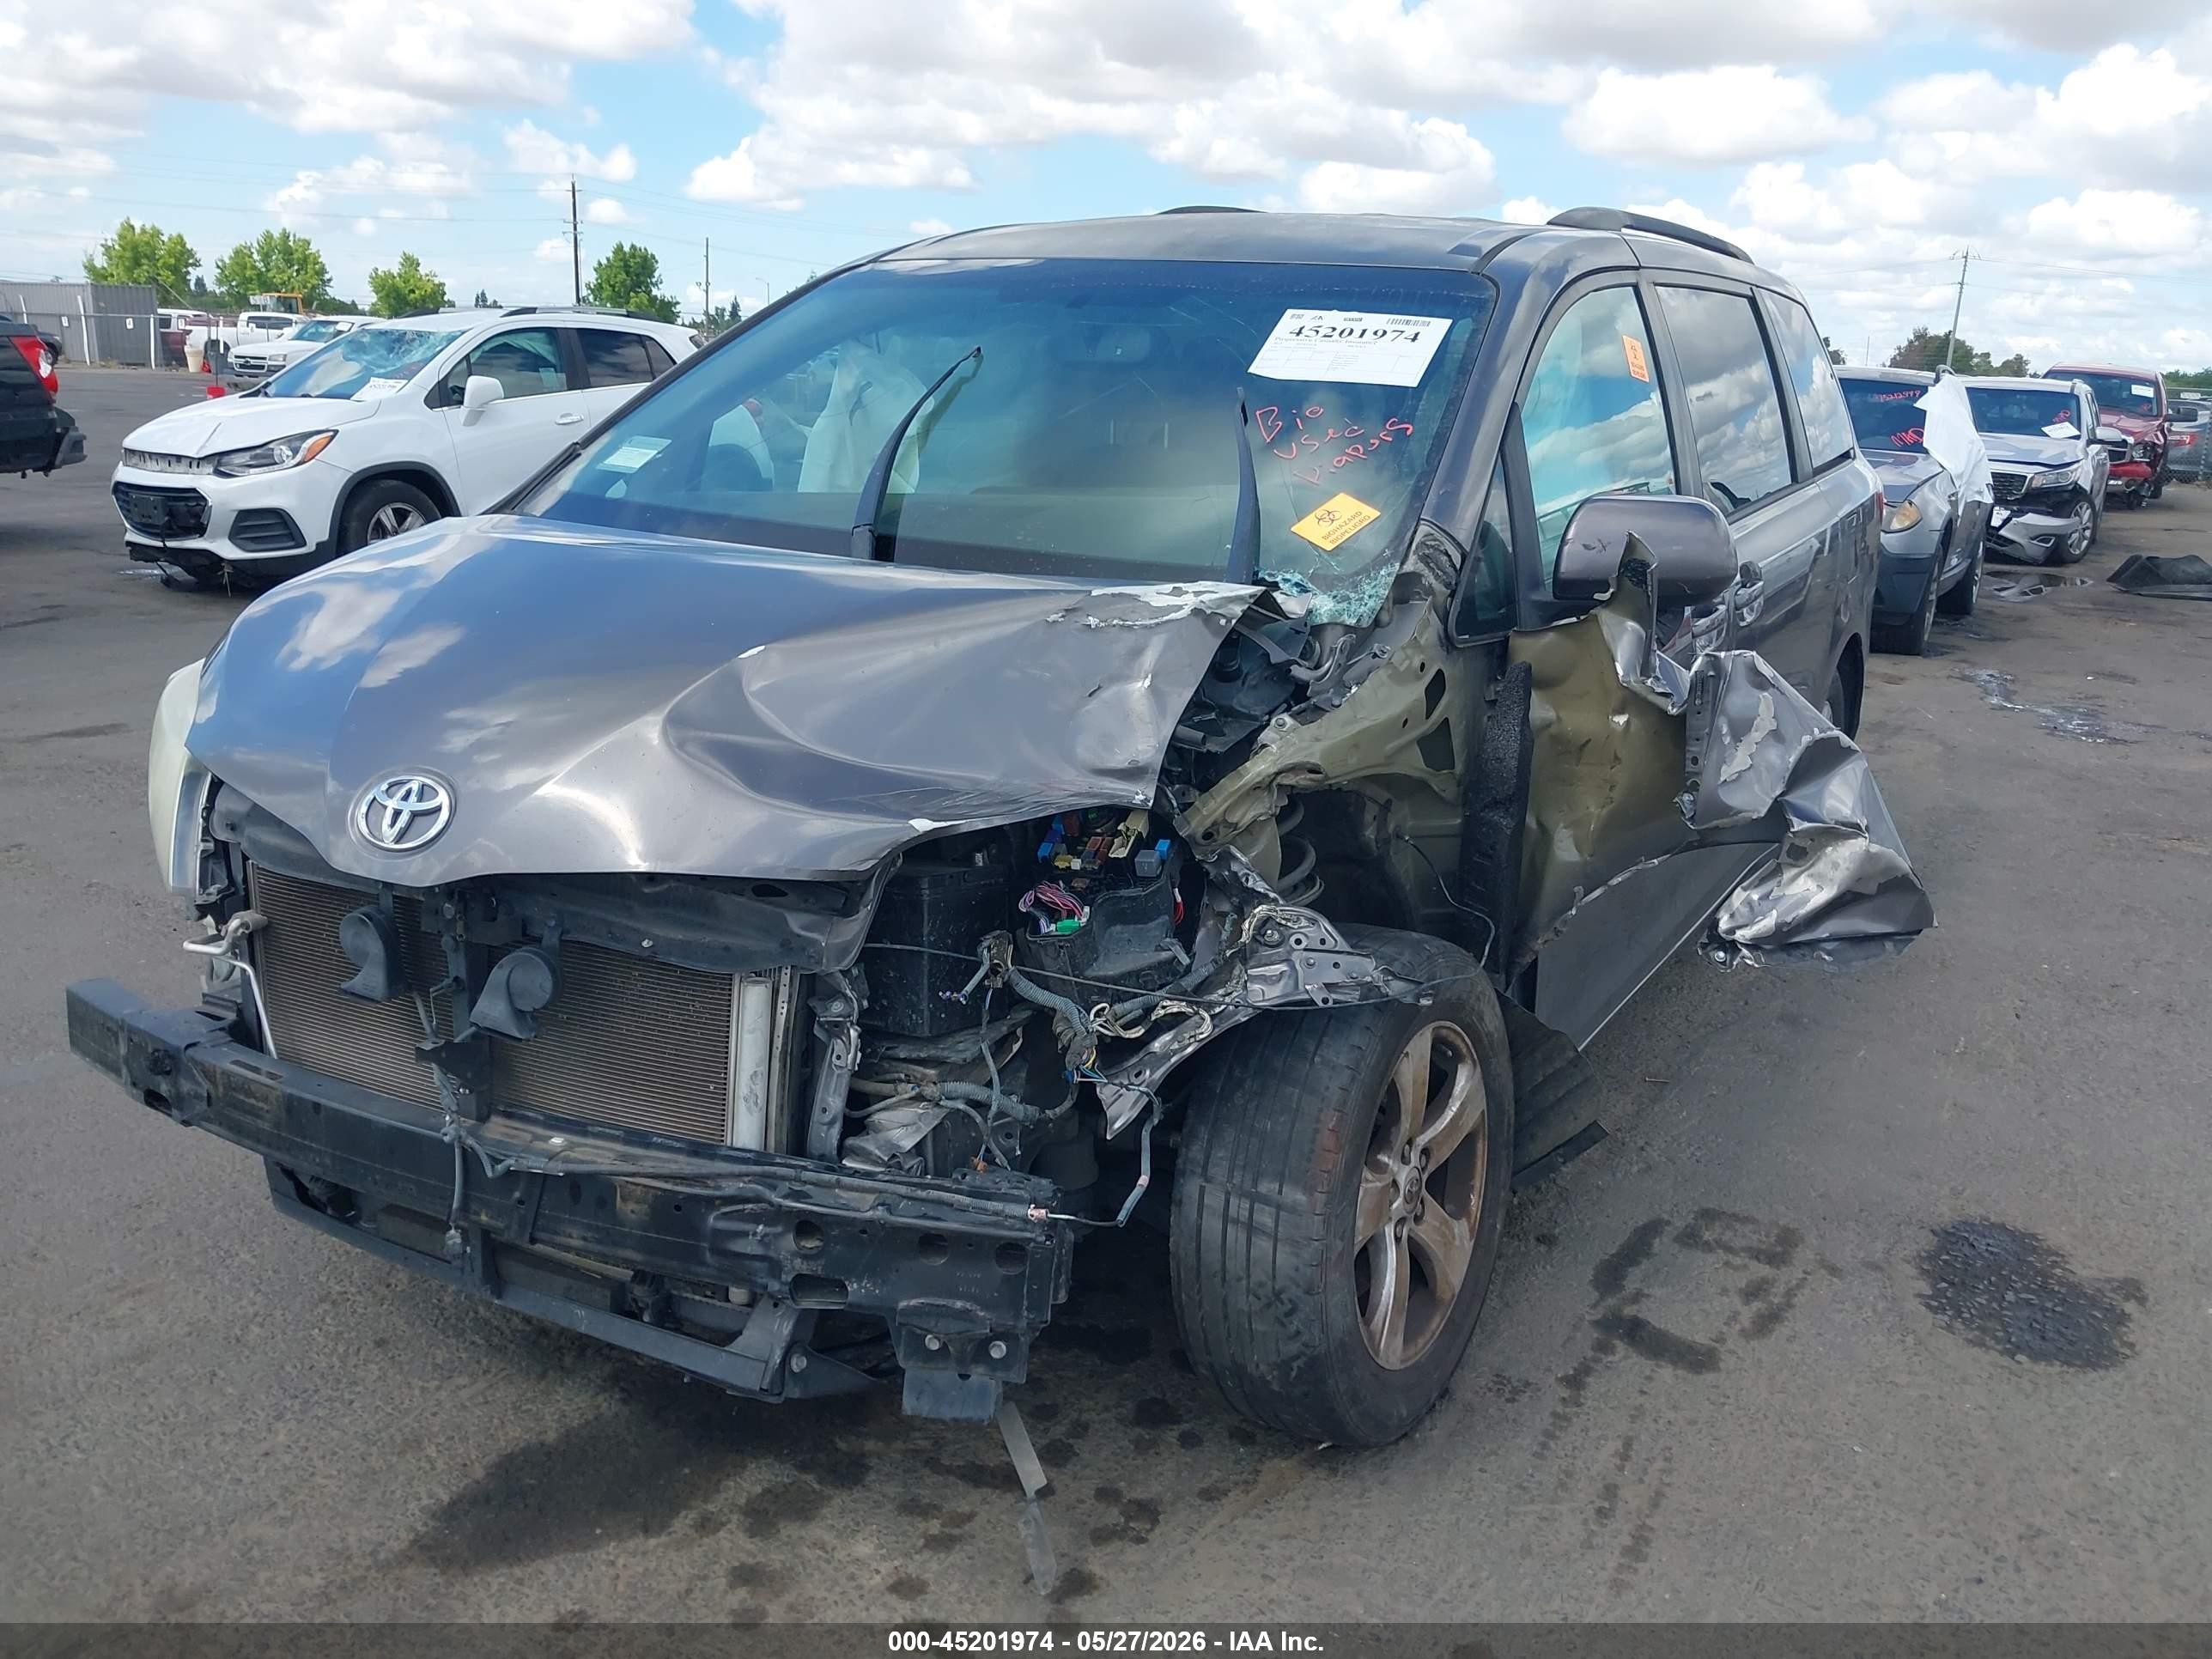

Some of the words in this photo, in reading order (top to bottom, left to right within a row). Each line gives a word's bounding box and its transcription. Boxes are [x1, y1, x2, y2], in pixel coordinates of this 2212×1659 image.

[1289, 325, 1421, 343] 45201974
[1322, 511, 1363, 541] BIOHAZARD
[1329, 515, 1371, 544] BIOPELIGRO
